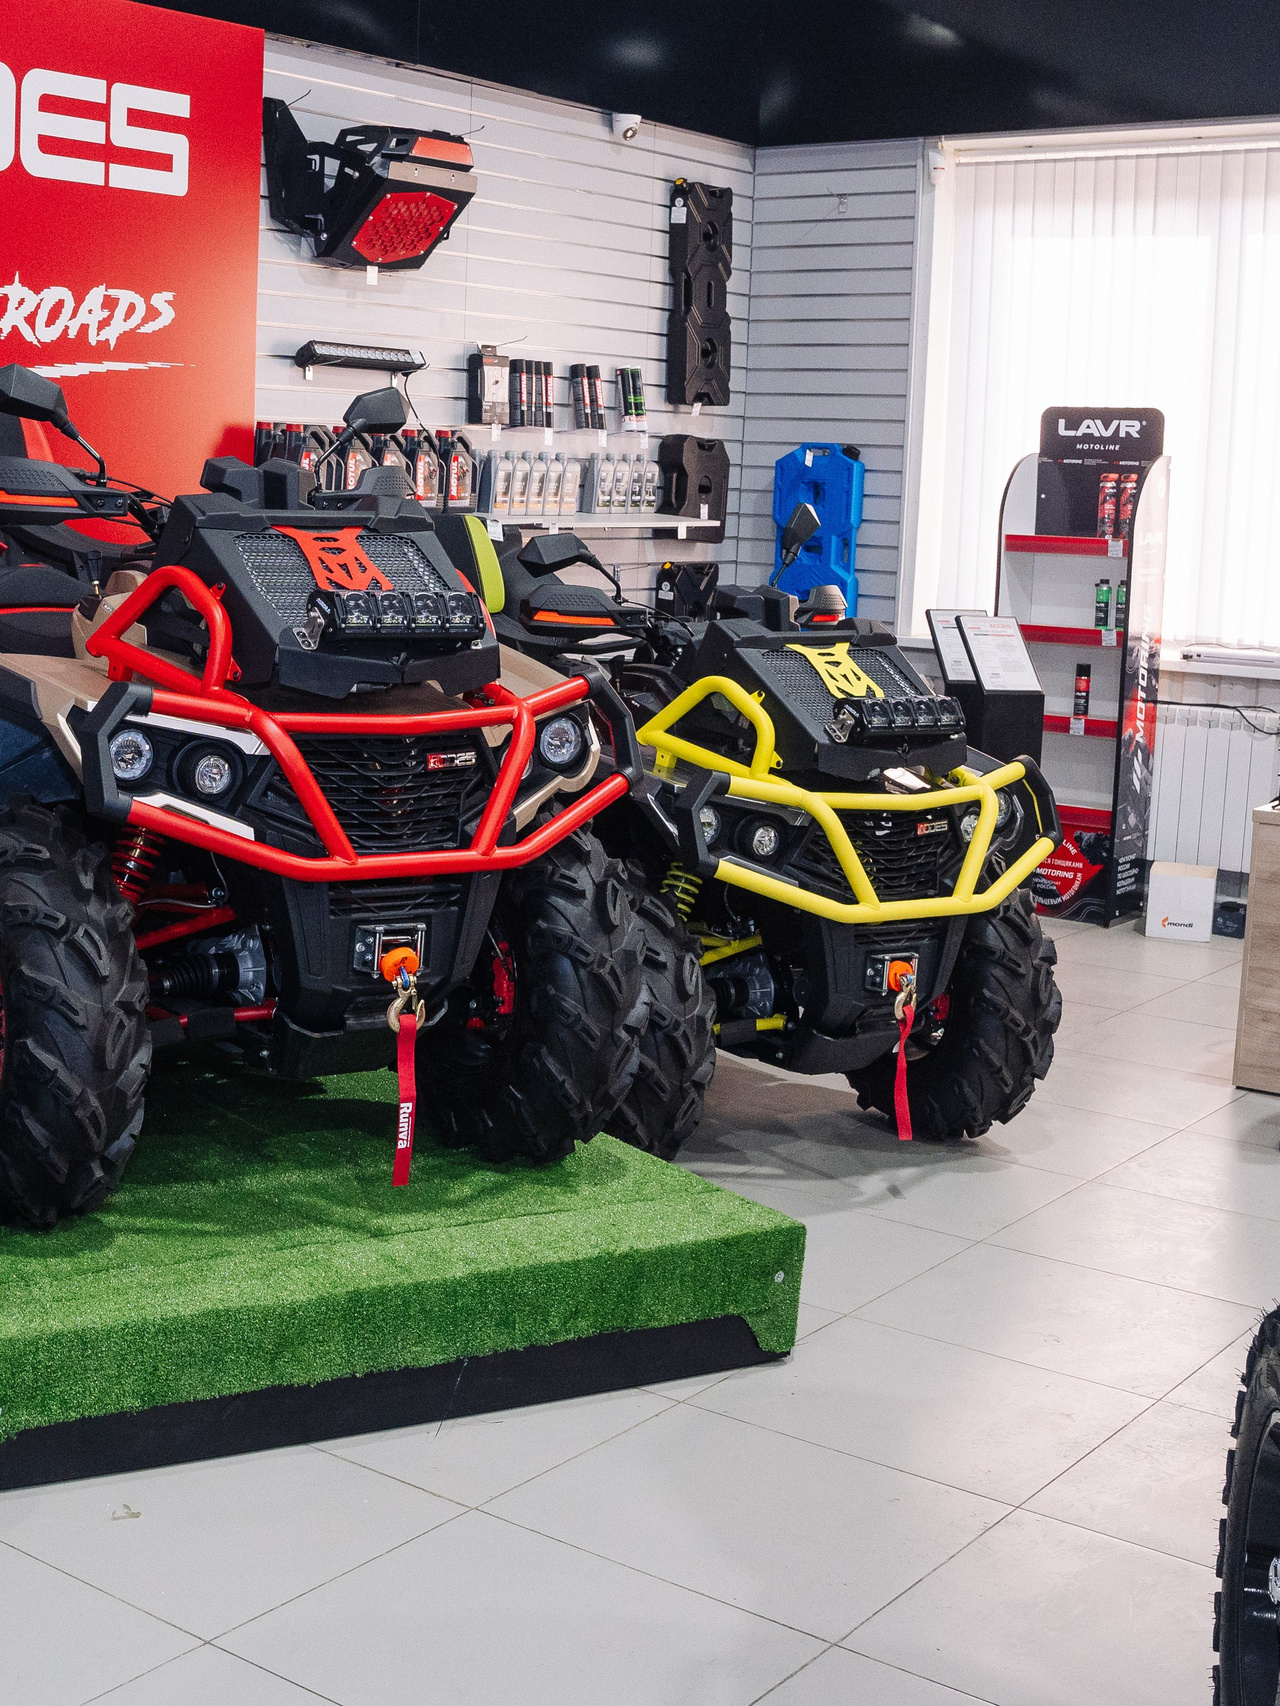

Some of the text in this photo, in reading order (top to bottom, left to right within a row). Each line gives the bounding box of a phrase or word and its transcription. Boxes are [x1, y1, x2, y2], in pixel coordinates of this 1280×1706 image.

[1058, 418, 1141, 438] LAVR
[1076, 443, 1121, 451] MOTOLINE
[417, 461, 425, 496] MOTUL
[450, 461, 458, 496] MOTUL
[1135, 604, 1151, 743] MOTORING
[917, 820, 948, 835] AODES
[1062, 839, 1078, 856] LINE
[1035, 867, 1075, 879] MOTORING
[1167, 921, 1194, 929] mondi
[397, 1102, 413, 1150] Runva
